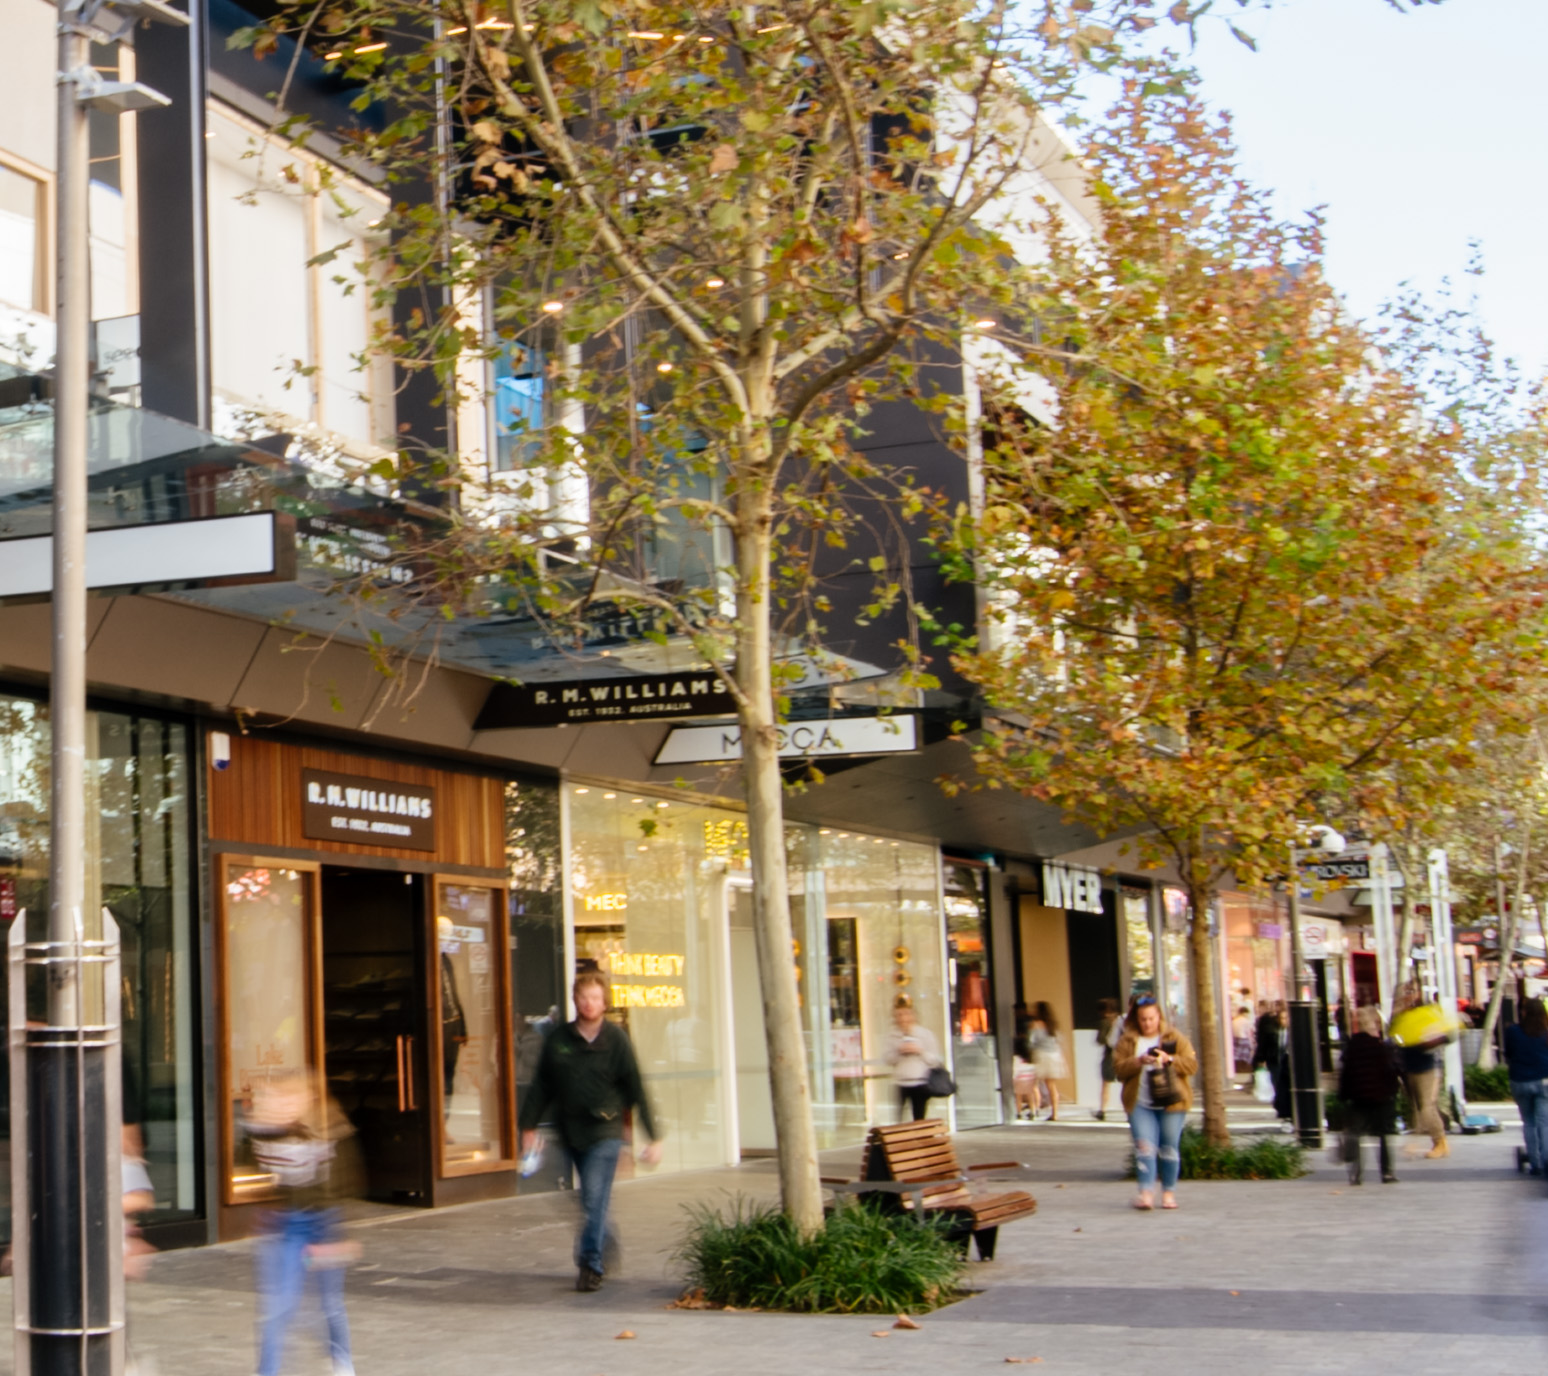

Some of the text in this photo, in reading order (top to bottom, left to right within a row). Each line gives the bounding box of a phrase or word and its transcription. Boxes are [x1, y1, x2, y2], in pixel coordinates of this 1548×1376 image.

[629, 702, 692, 714] AUSTRALIA
[721, 727, 837, 754] MCCA
[1043, 861, 1104, 914] MYER
[585, 893, 627, 911] MEC
